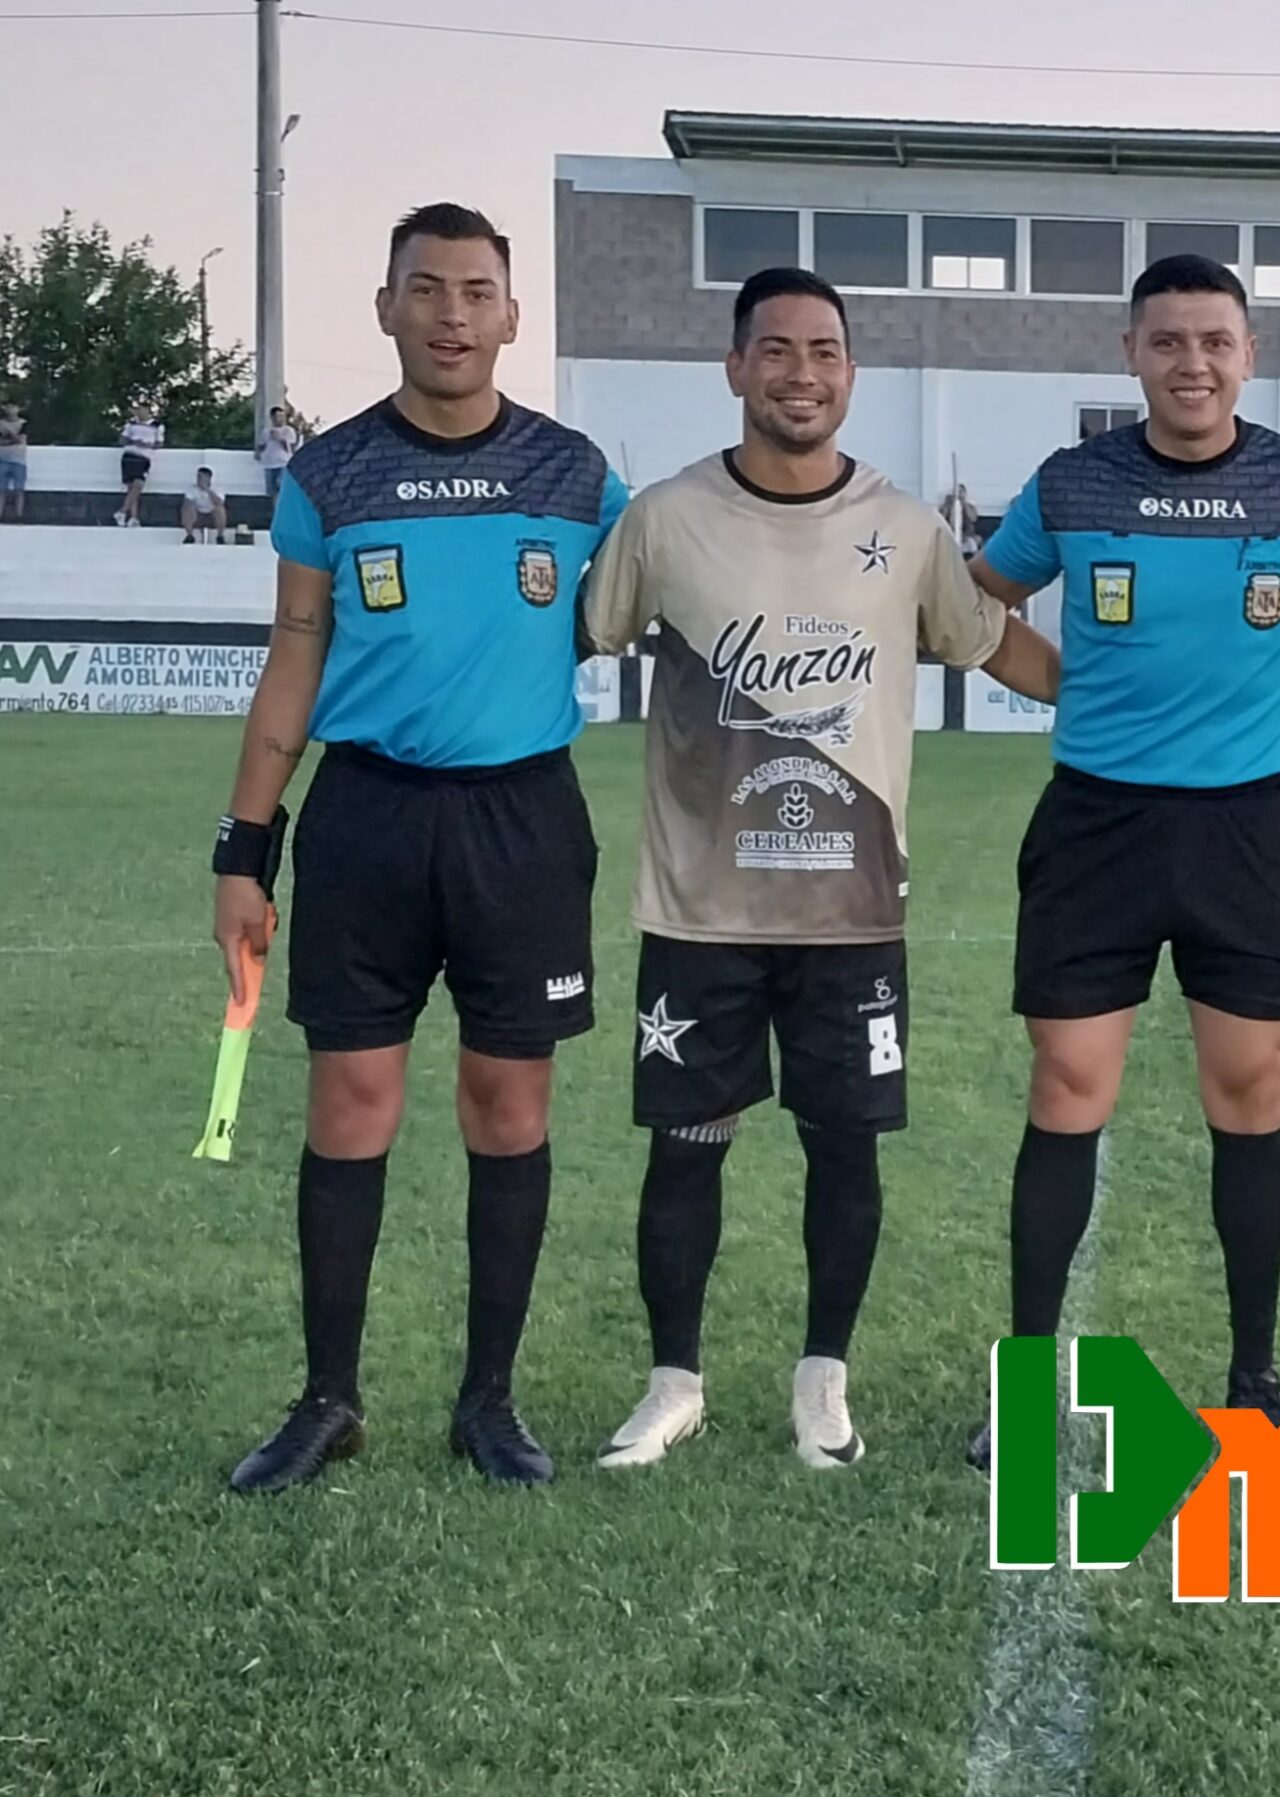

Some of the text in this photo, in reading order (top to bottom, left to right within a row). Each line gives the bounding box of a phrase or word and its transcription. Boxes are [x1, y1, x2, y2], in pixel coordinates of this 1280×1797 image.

[418, 478, 512, 499] SADRA
[1159, 498, 1248, 519] SADRA
[785, 616, 849, 635] Fideos
[89, 646, 180, 667] ALBERTO
[712, 614, 877, 726] Yanzón
[58, 692, 90, 711] 764
[736, 830, 855, 851] CEREALES
[868, 1013, 903, 1077] 8
